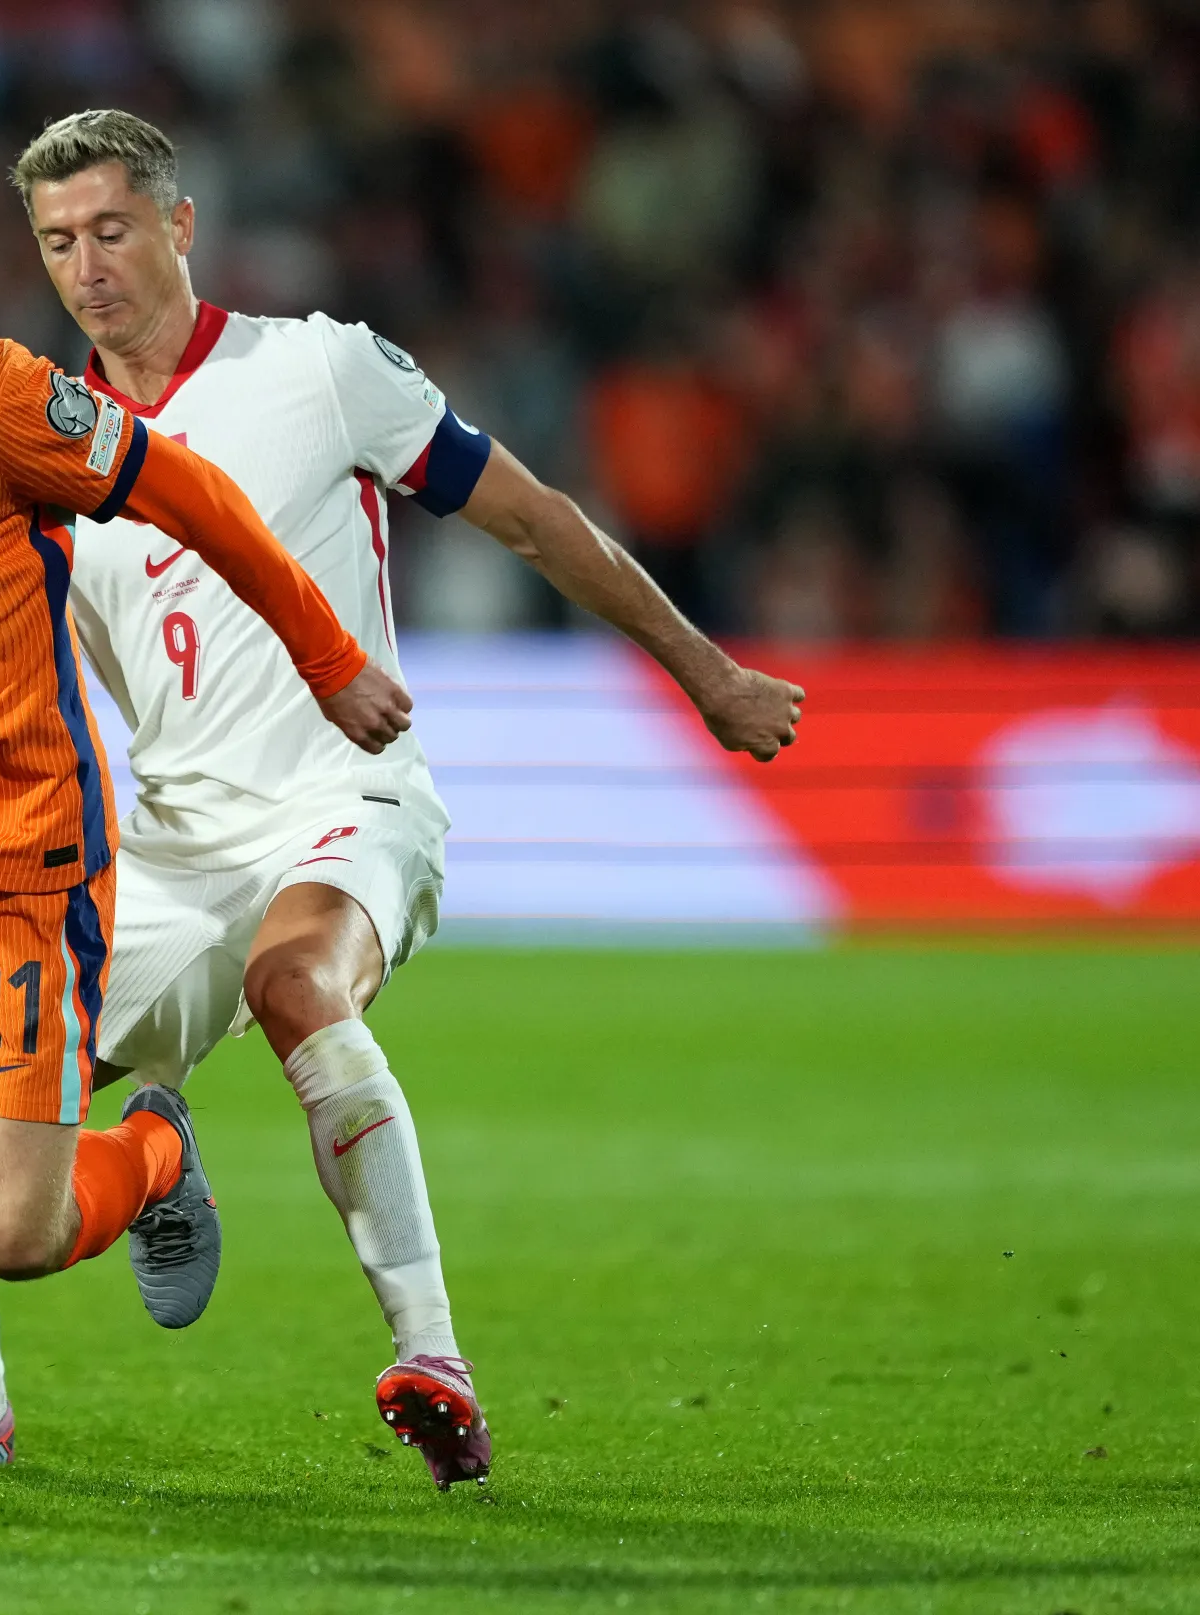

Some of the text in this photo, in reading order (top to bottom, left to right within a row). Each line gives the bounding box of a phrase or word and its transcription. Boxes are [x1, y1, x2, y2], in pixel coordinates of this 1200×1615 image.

[96, 412, 115, 471] FOUNDATION
[175, 577, 200, 589] POLSKA
[162, 611, 200, 700] 9
